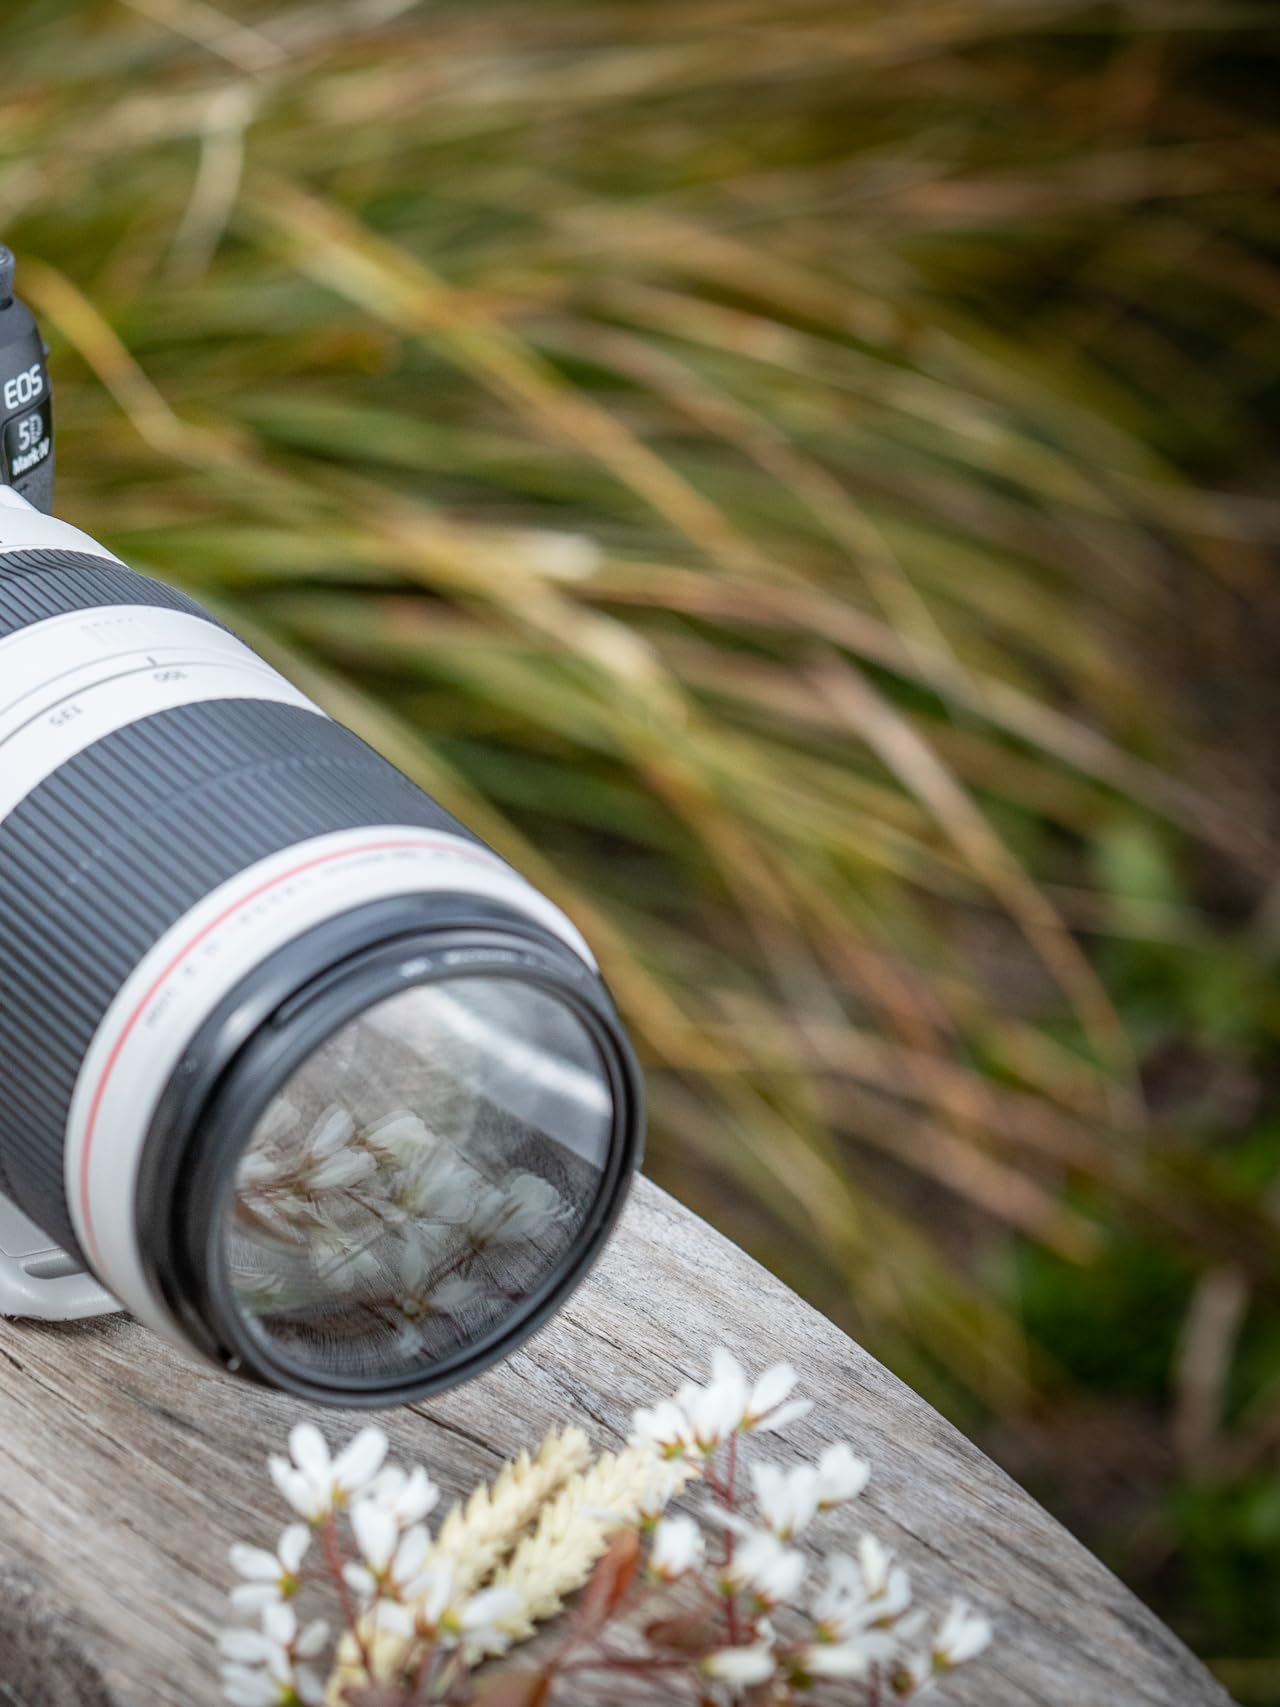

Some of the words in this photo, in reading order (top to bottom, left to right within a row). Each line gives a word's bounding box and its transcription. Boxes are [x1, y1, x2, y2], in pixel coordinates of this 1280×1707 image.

[4, 364, 43, 410] EOS
[18, 413, 43, 451] 5D
[50, 705, 83, 727] 135
